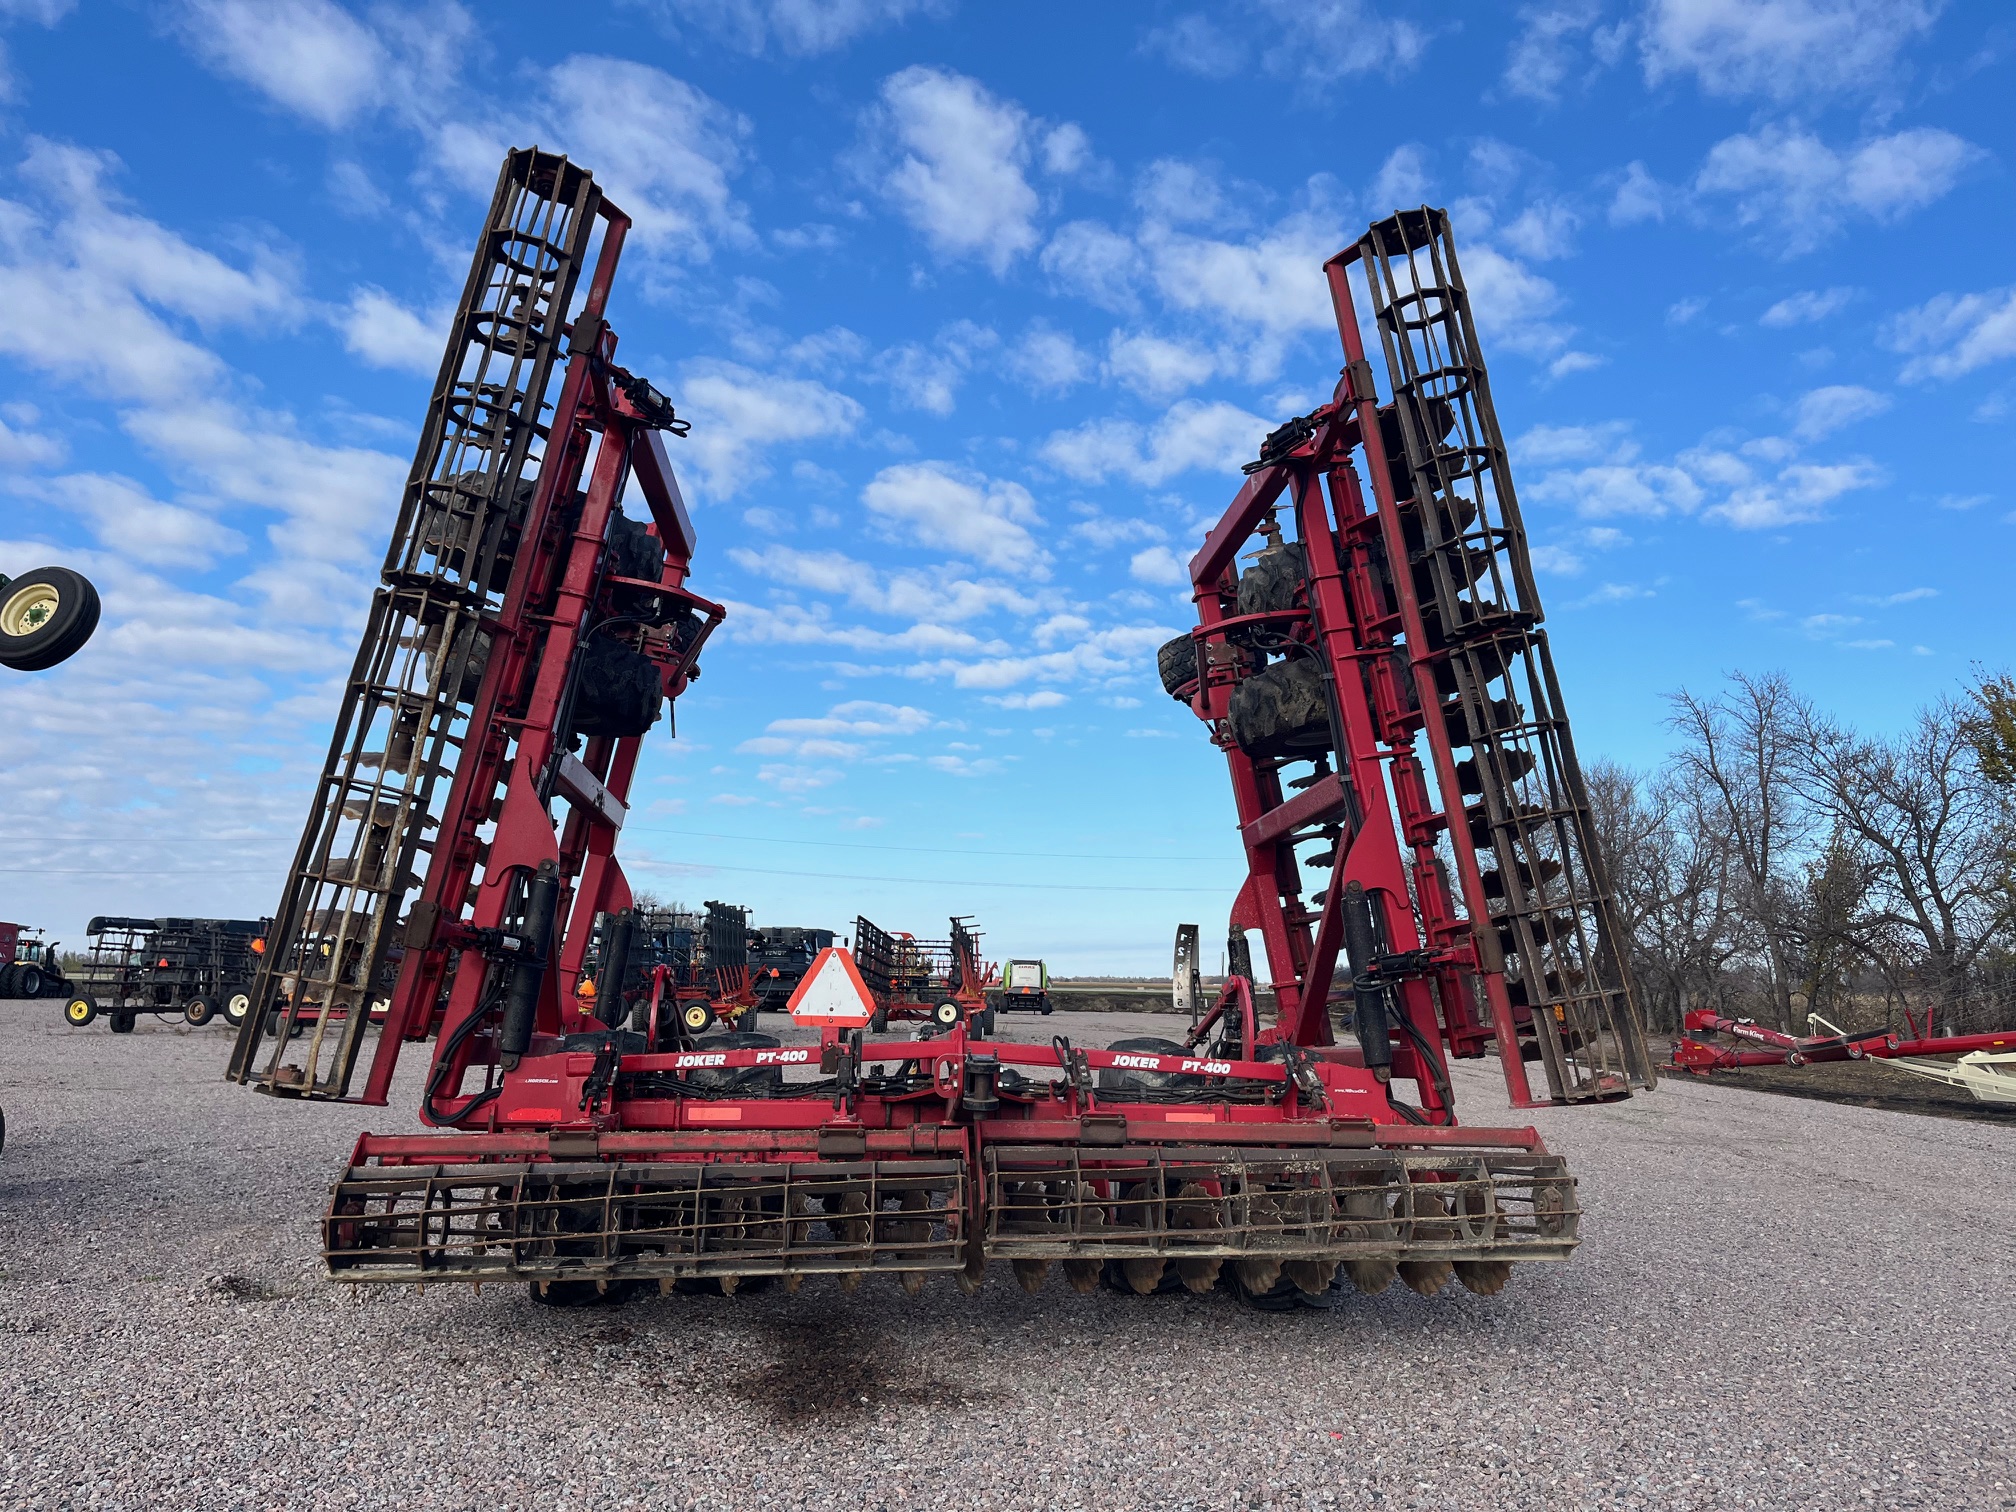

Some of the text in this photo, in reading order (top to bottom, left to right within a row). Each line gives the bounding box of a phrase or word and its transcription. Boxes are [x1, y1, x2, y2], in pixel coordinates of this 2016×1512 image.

[1732, 1025, 1765, 1041] Farm King
[675, 1050, 808, 1067] JOKER PT-400
[1112, 1054, 1231, 1074] JOKER PT-400
